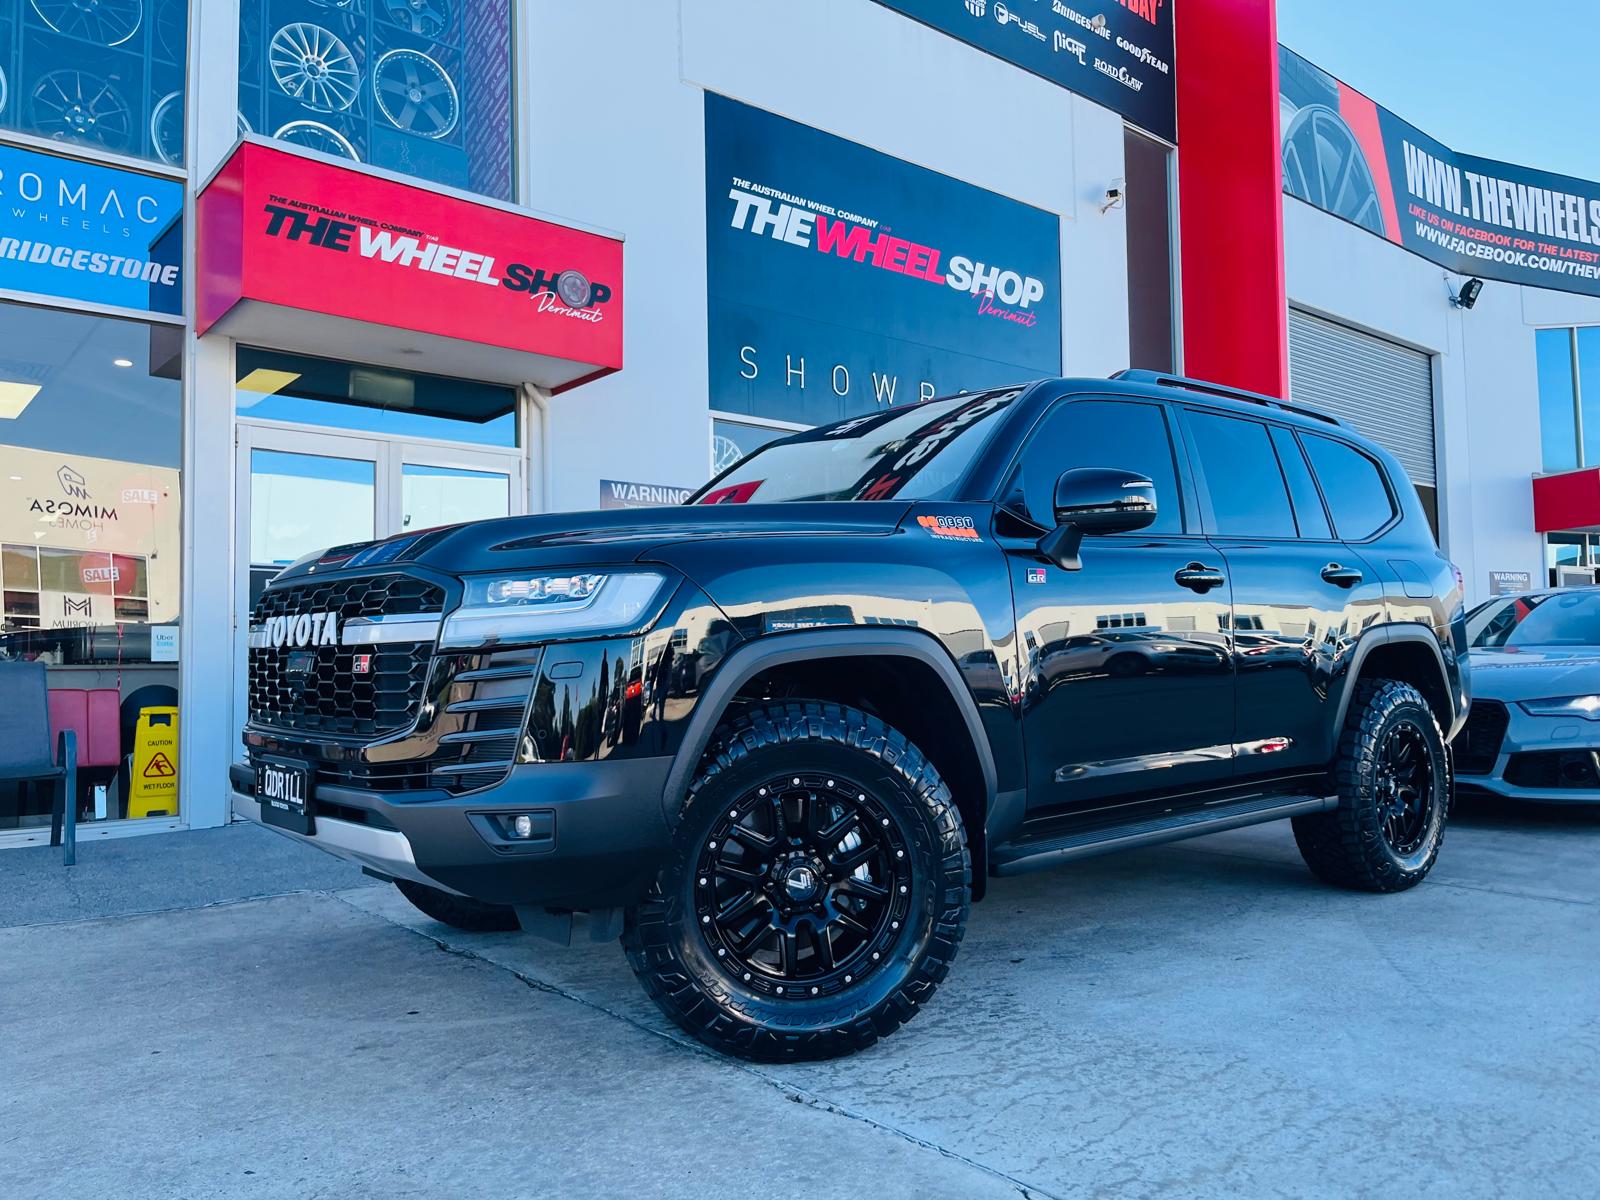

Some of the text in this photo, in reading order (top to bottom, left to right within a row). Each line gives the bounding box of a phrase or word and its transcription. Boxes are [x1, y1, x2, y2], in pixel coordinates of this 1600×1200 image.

[1008, 13, 1048, 40] FUEL
[1053, 29, 1086, 66] NICHE
[1116, 36, 1169, 74] GOODYEAR
[0, 169, 158, 223] OMAC
[732, 177, 751, 189] THE
[751, 183, 806, 206] AUSTRALIAN
[807, 201, 836, 217] WHEEL
[837, 209, 878, 229] COMPANY
[12, 207, 130, 237] WHEELS
[268, 194, 288, 205] THE
[288, 199, 346, 218] AUSTRALIAN
[348, 214, 379, 227] WHEEL
[380, 222, 424, 238] COMPANY
[1408, 203, 1599, 263] LIKE US ON FACEBOOK FOR THE LATEST
[264, 204, 611, 309] THE WHEEL SHOP
[729, 188, 1044, 308] THE WHEEL SHOP
[530, 290, 603, 323] Derrimut
[972, 289, 1038, 327] Derrimut
[739, 346, 968, 405] SHOWR
[123, 490, 156, 502] SALE
[611, 482, 691, 504] WARNING
[84, 568, 118, 582] SALE
[1028, 574, 1045, 583] GR
[1493, 572, 1528, 581] WARNING
[266, 611, 337, 647] TOYOTA
[156, 782, 175, 790] FLOOR
[265, 769, 303, 805] QDRILL
